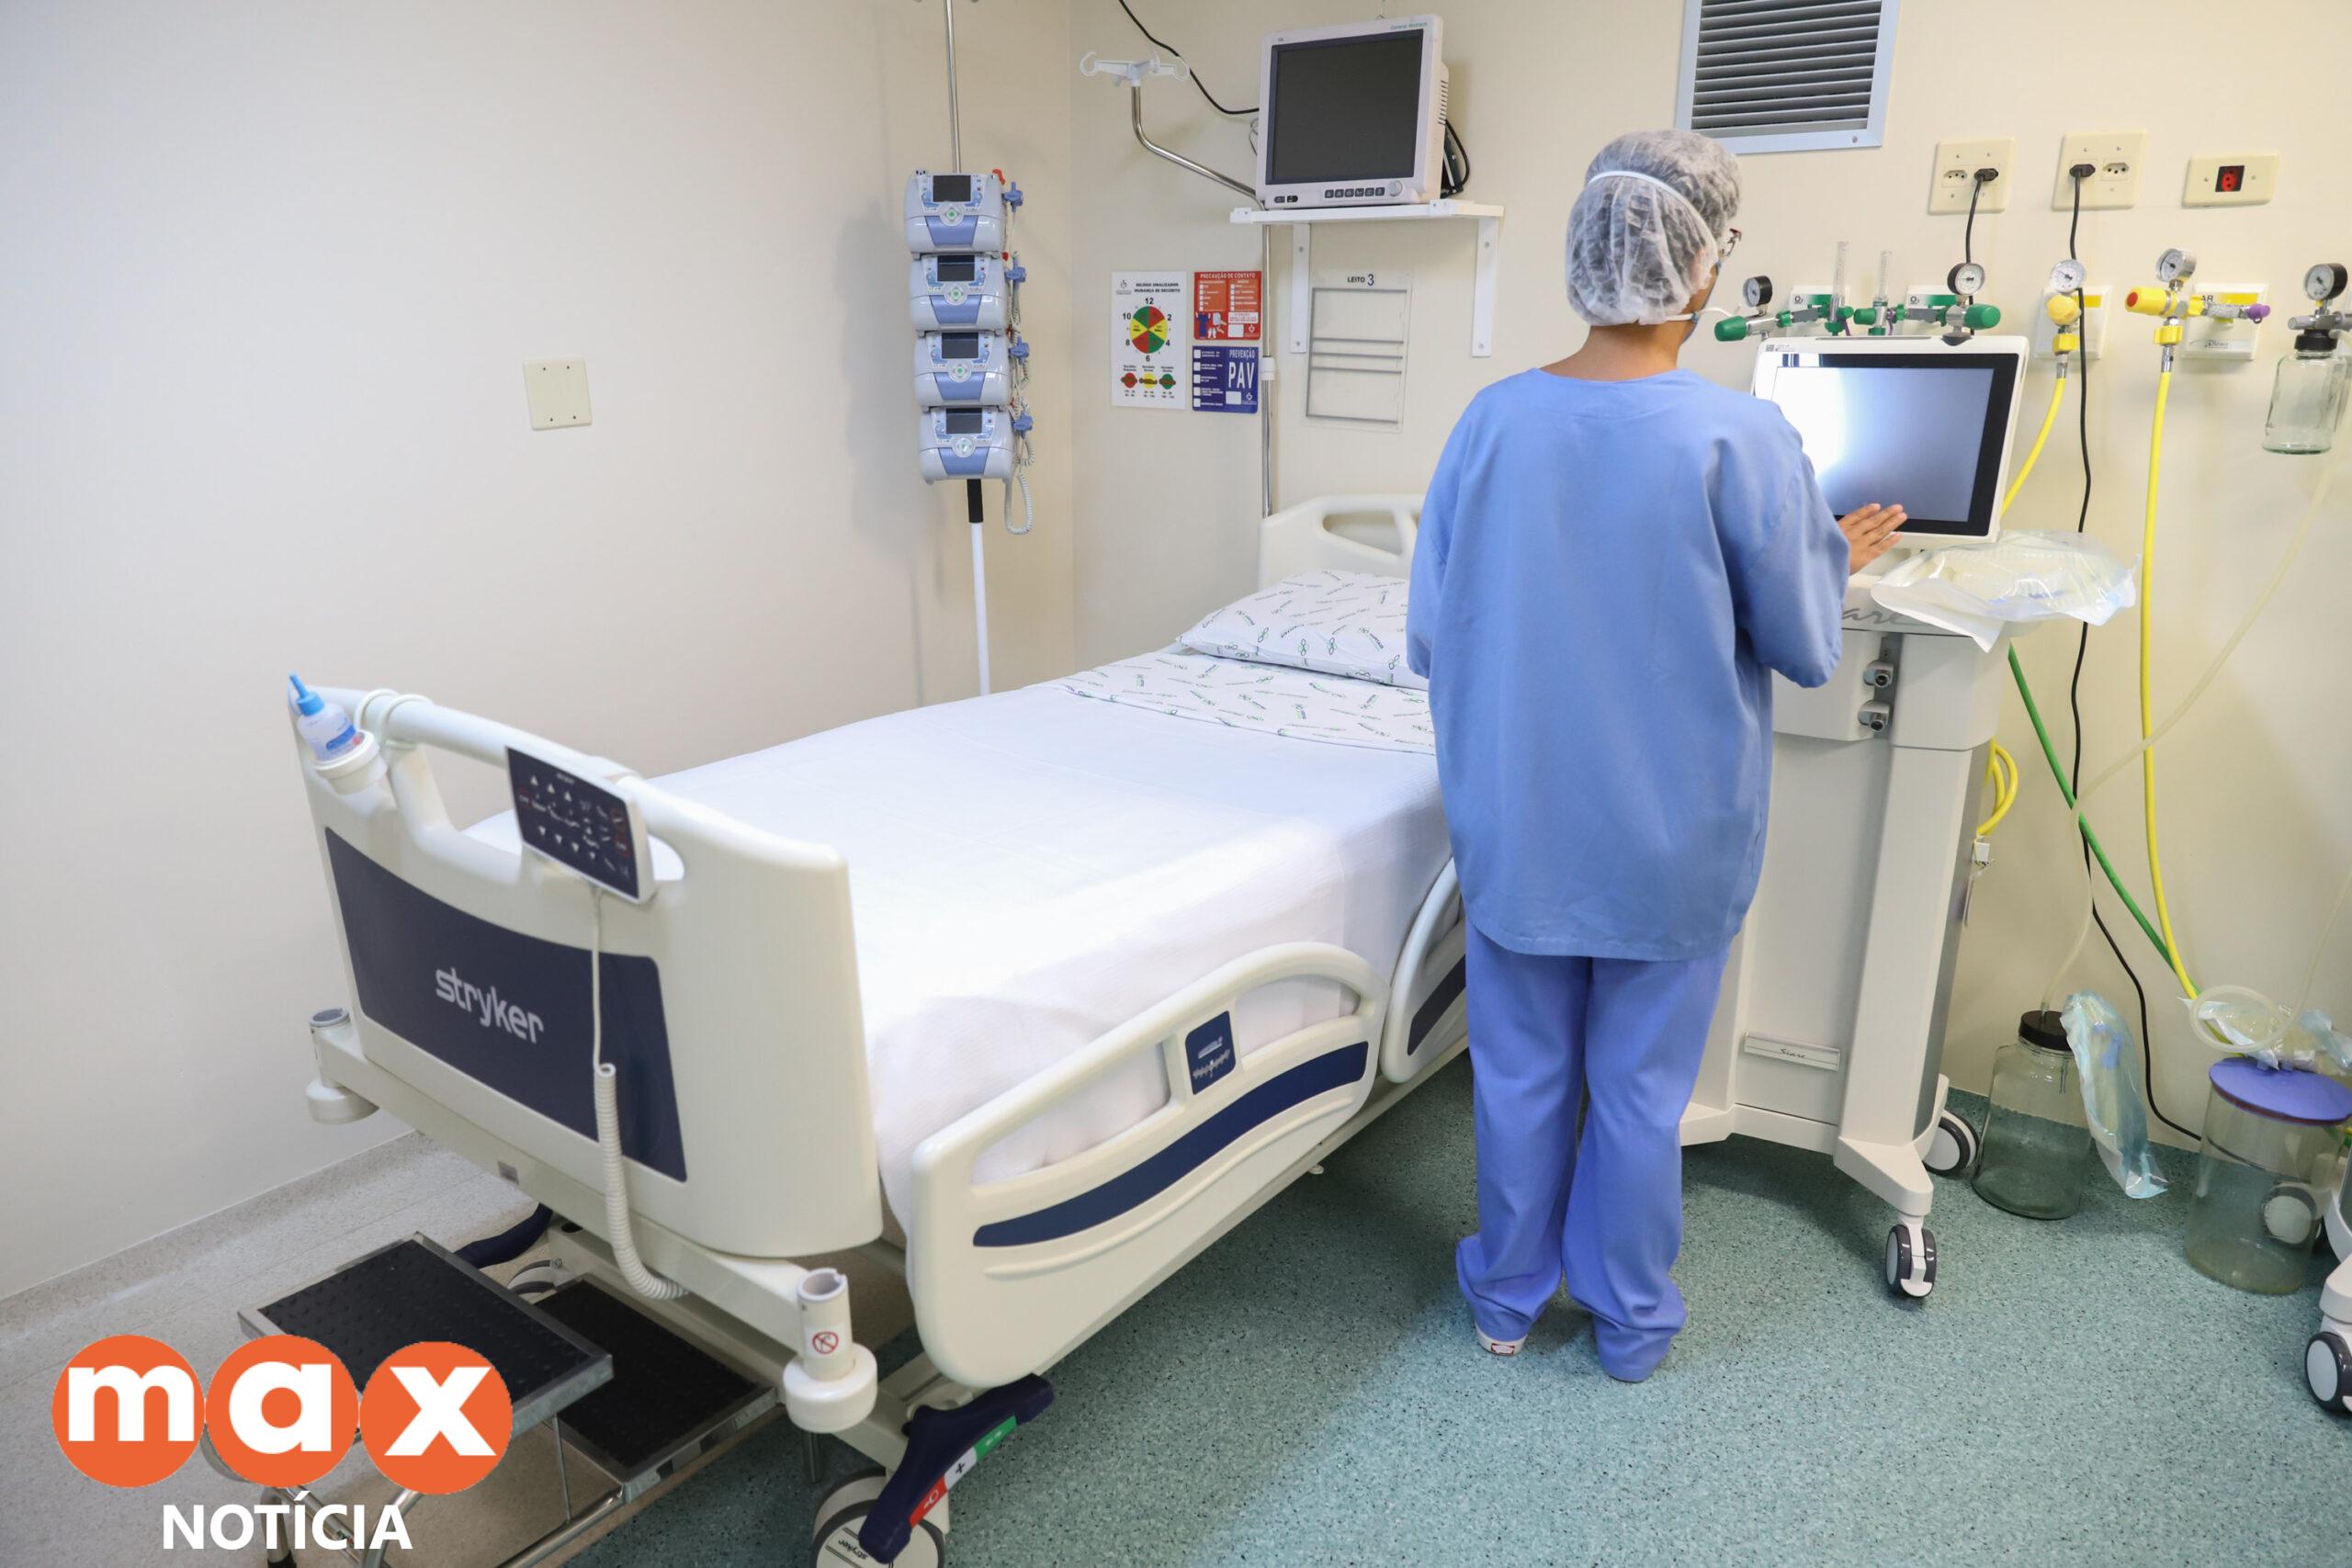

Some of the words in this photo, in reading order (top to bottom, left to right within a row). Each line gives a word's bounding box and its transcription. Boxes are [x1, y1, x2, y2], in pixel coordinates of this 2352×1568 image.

[1367, 274, 1374, 287] 3
[1145, 297, 1154, 305] 12
[1123, 312, 1132, 321] 10
[1167, 313, 1172, 321] 2
[1229, 347, 1256, 360] PREVENÇÃO
[1228, 361, 1255, 389] PAV
[435, 967, 544, 1044] stryker
